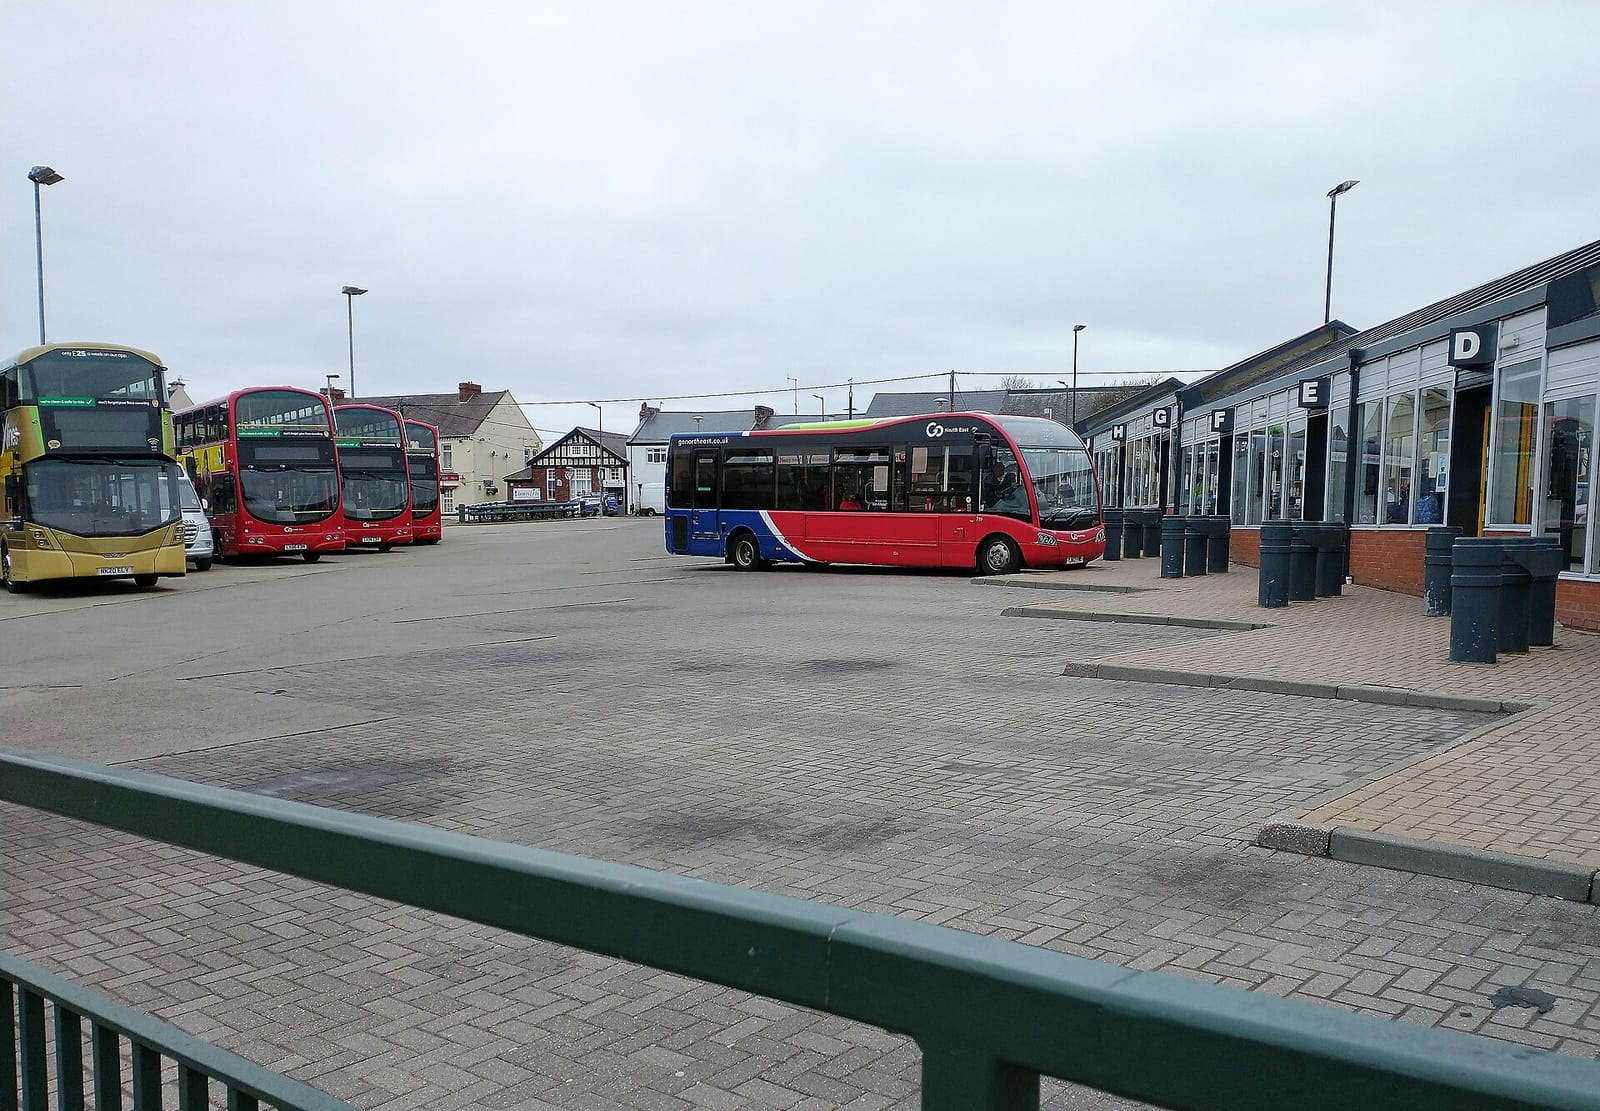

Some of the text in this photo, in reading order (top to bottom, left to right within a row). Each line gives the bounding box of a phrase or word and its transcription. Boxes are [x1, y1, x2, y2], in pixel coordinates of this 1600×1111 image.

[1454, 331, 1480, 360] D
[1302, 382, 1319, 403] E
[1155, 409, 1167, 424] G
[1214, 411, 1226, 428] F
[1113, 425, 1124, 439] H
[677, 436, 729, 447] gonortheast.co.uk
